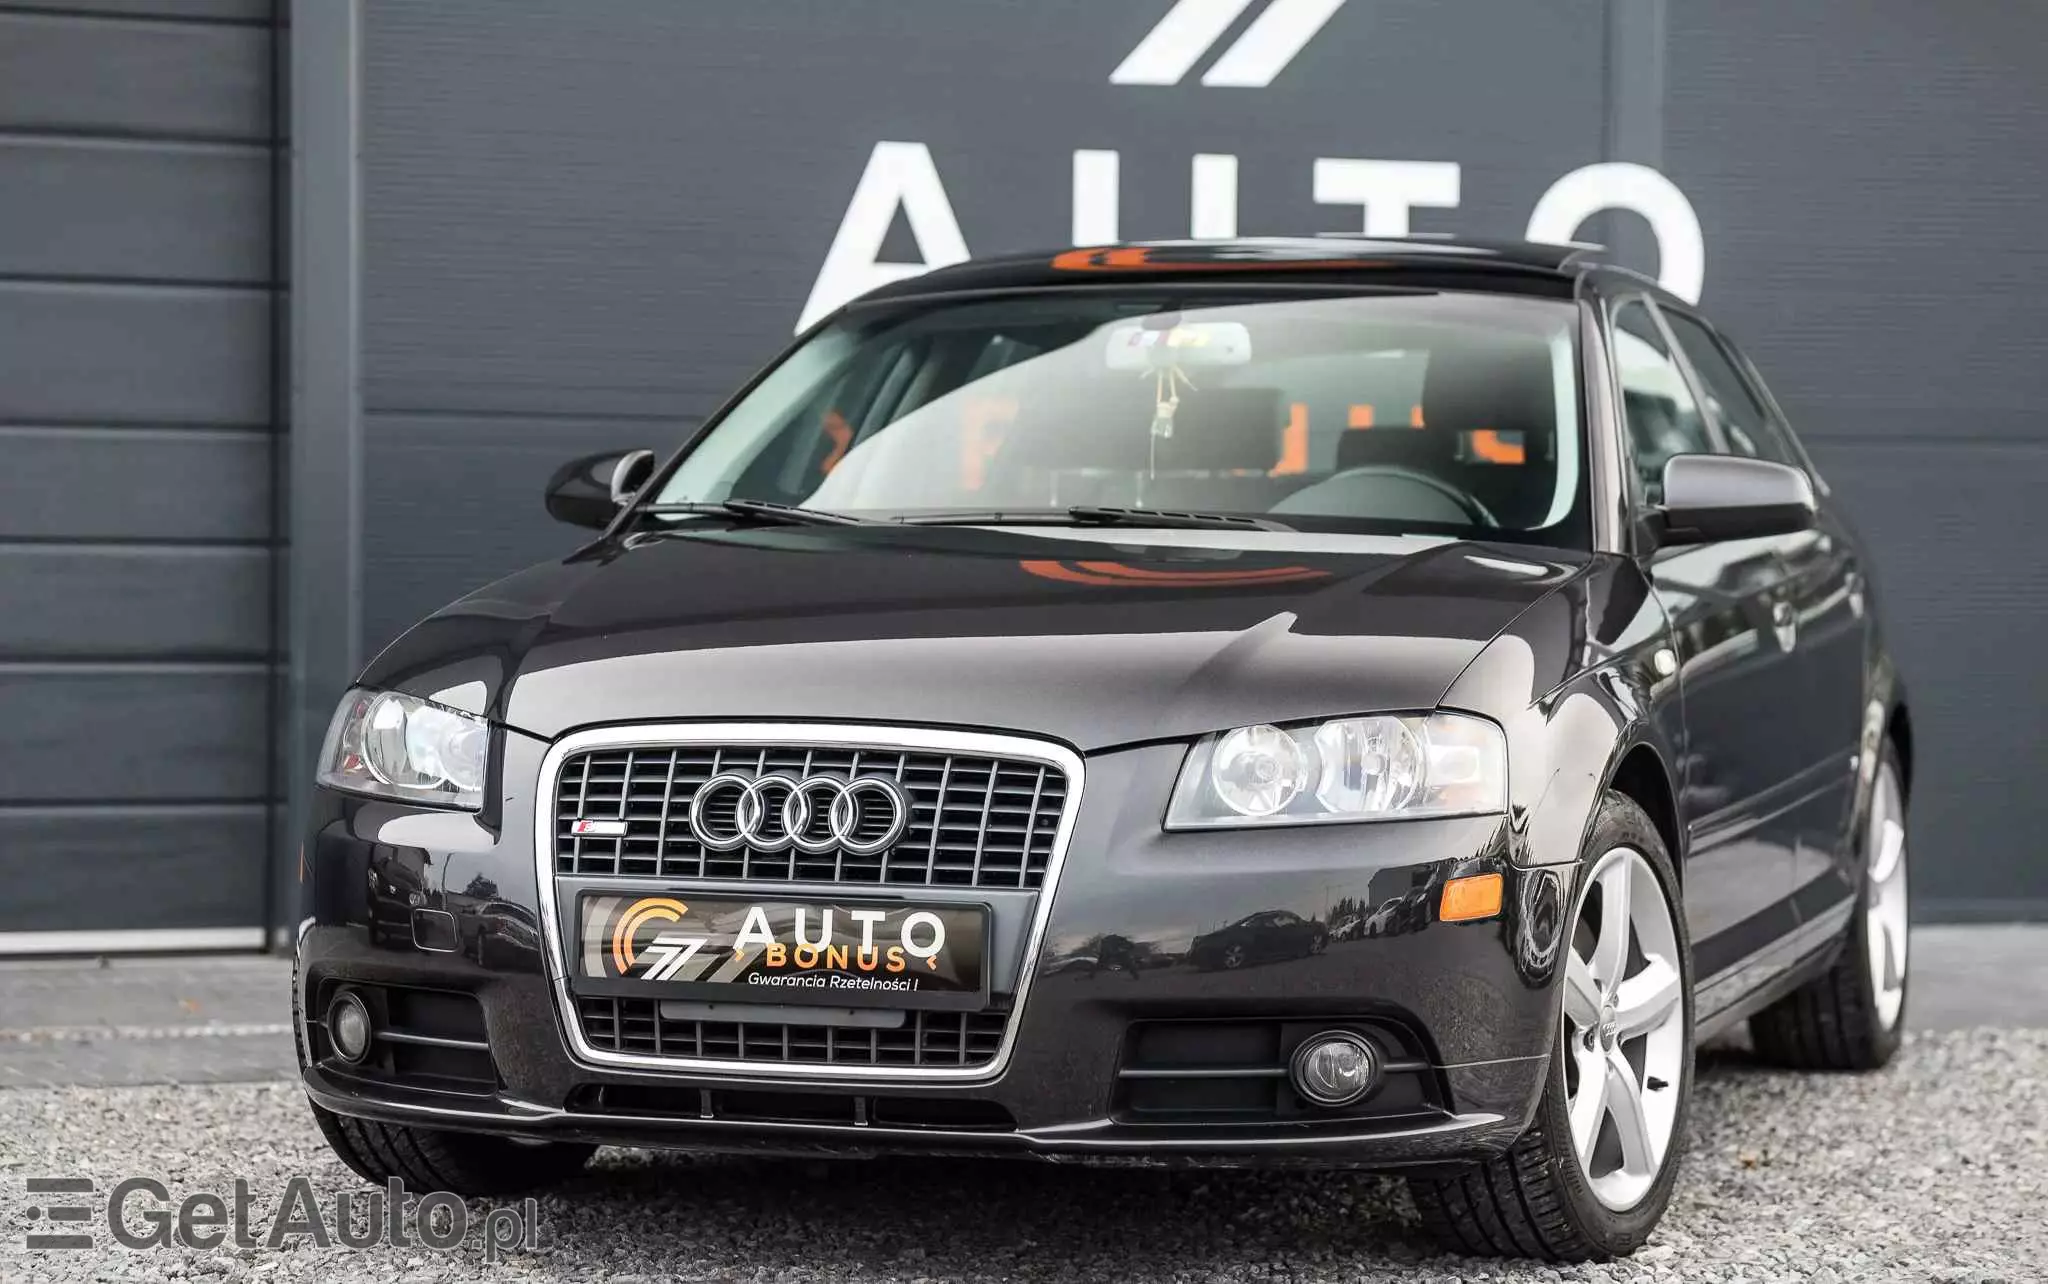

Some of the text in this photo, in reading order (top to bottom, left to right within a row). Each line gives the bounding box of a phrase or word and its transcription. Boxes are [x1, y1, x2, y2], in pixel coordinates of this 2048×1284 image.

[732, 906, 946, 958] AUTO
[766, 942, 906, 973] BONUS
[747, 972, 826, 989] Gwarancia
[829, 975, 911, 992] Rzetelności
